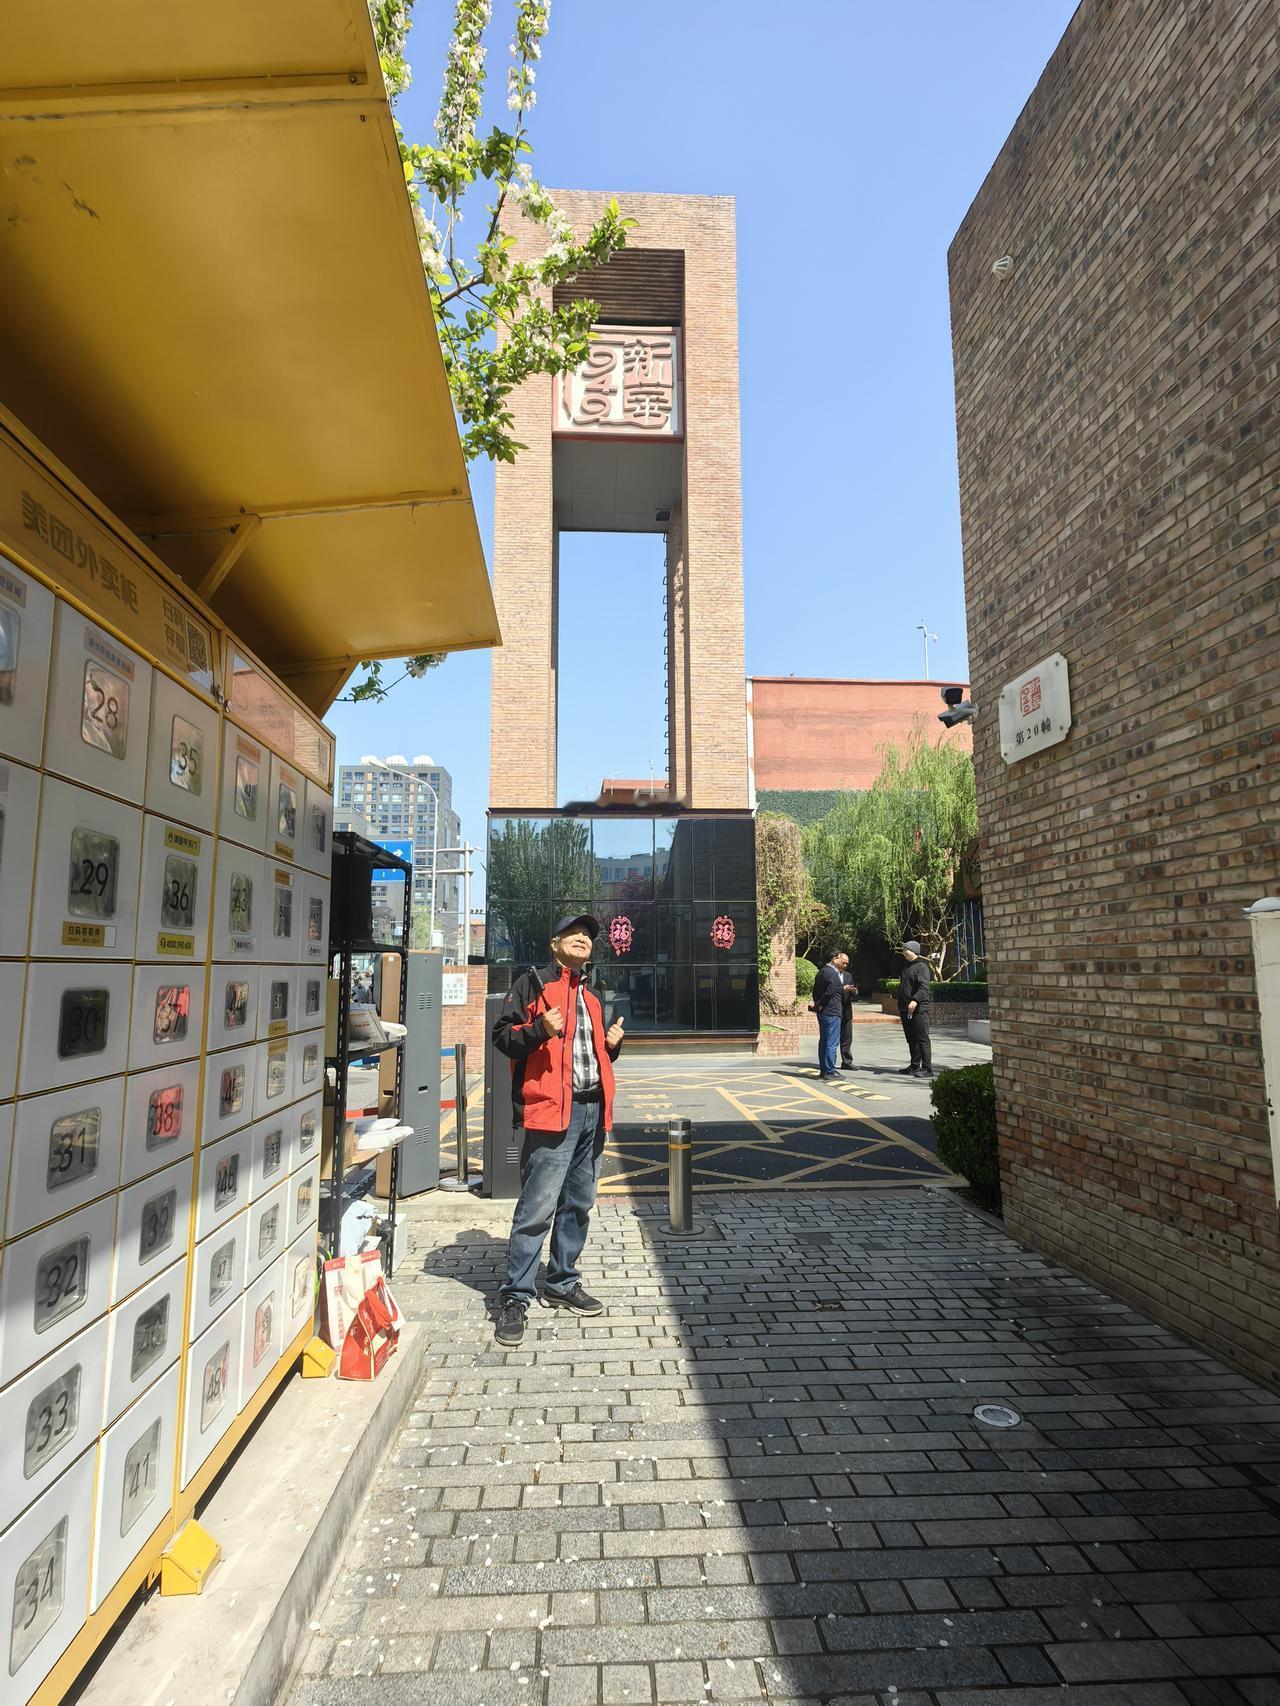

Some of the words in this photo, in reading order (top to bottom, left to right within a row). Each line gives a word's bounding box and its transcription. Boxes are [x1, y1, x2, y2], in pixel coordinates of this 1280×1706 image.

[20, 490, 140, 616] 美团外卖柜
[90, 684, 119, 731] 28
[179, 742, 198, 776] 35
[79, 858, 109, 897] 29
[169, 880, 190, 912] 36
[158, 1001, 182, 1033] 37
[57, 1126, 87, 1173] 31
[146, 1206, 169, 1248] 39
[47, 1254, 79, 1308] 32
[206, 1366, 222, 1402] 48
[36, 1390, 69, 1453] 33
[128, 1451, 150, 1499] 41
[23, 1556, 55, 1631] 34
